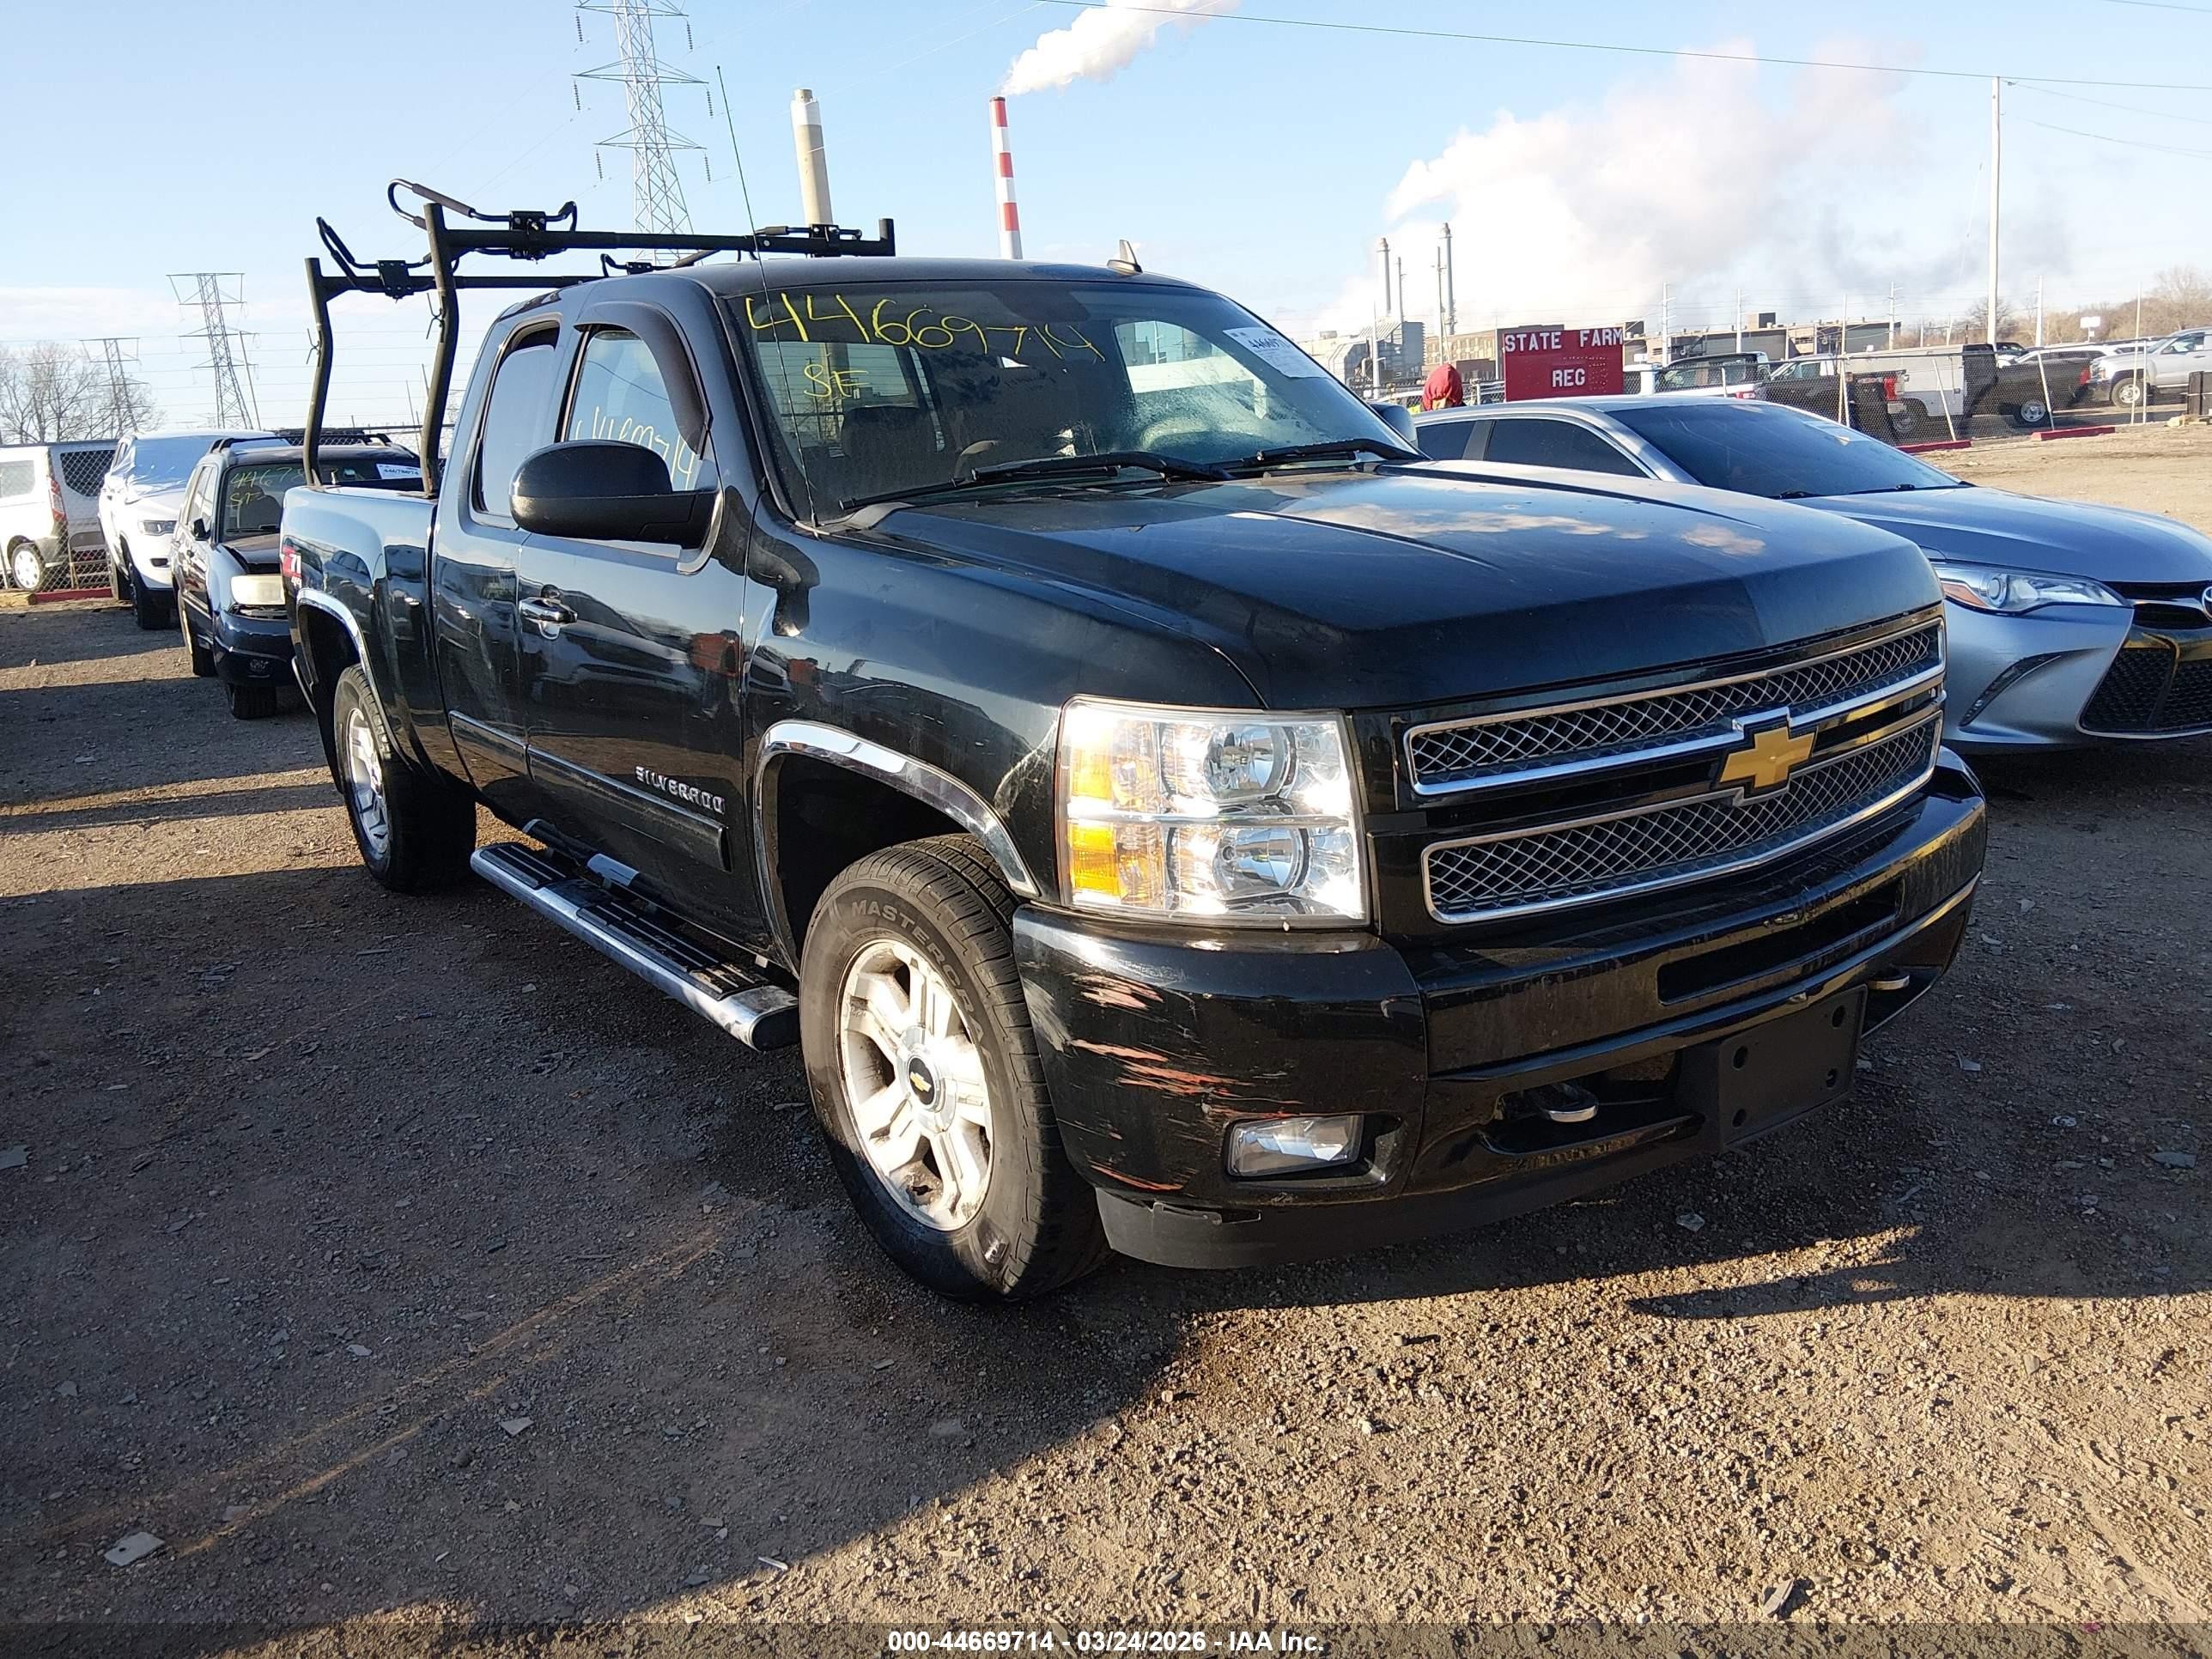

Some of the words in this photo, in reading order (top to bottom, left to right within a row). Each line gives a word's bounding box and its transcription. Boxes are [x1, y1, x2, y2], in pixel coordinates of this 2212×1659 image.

[745, 293, 1106, 362] 44669714
[1504, 331, 1562, 352] STATE
[1580, 328, 1623, 348] FARM
[1552, 368, 1586, 387] REG
[635, 765, 726, 815] SILVERADO
[852, 900, 1003, 1108] MASTERCRAFT
